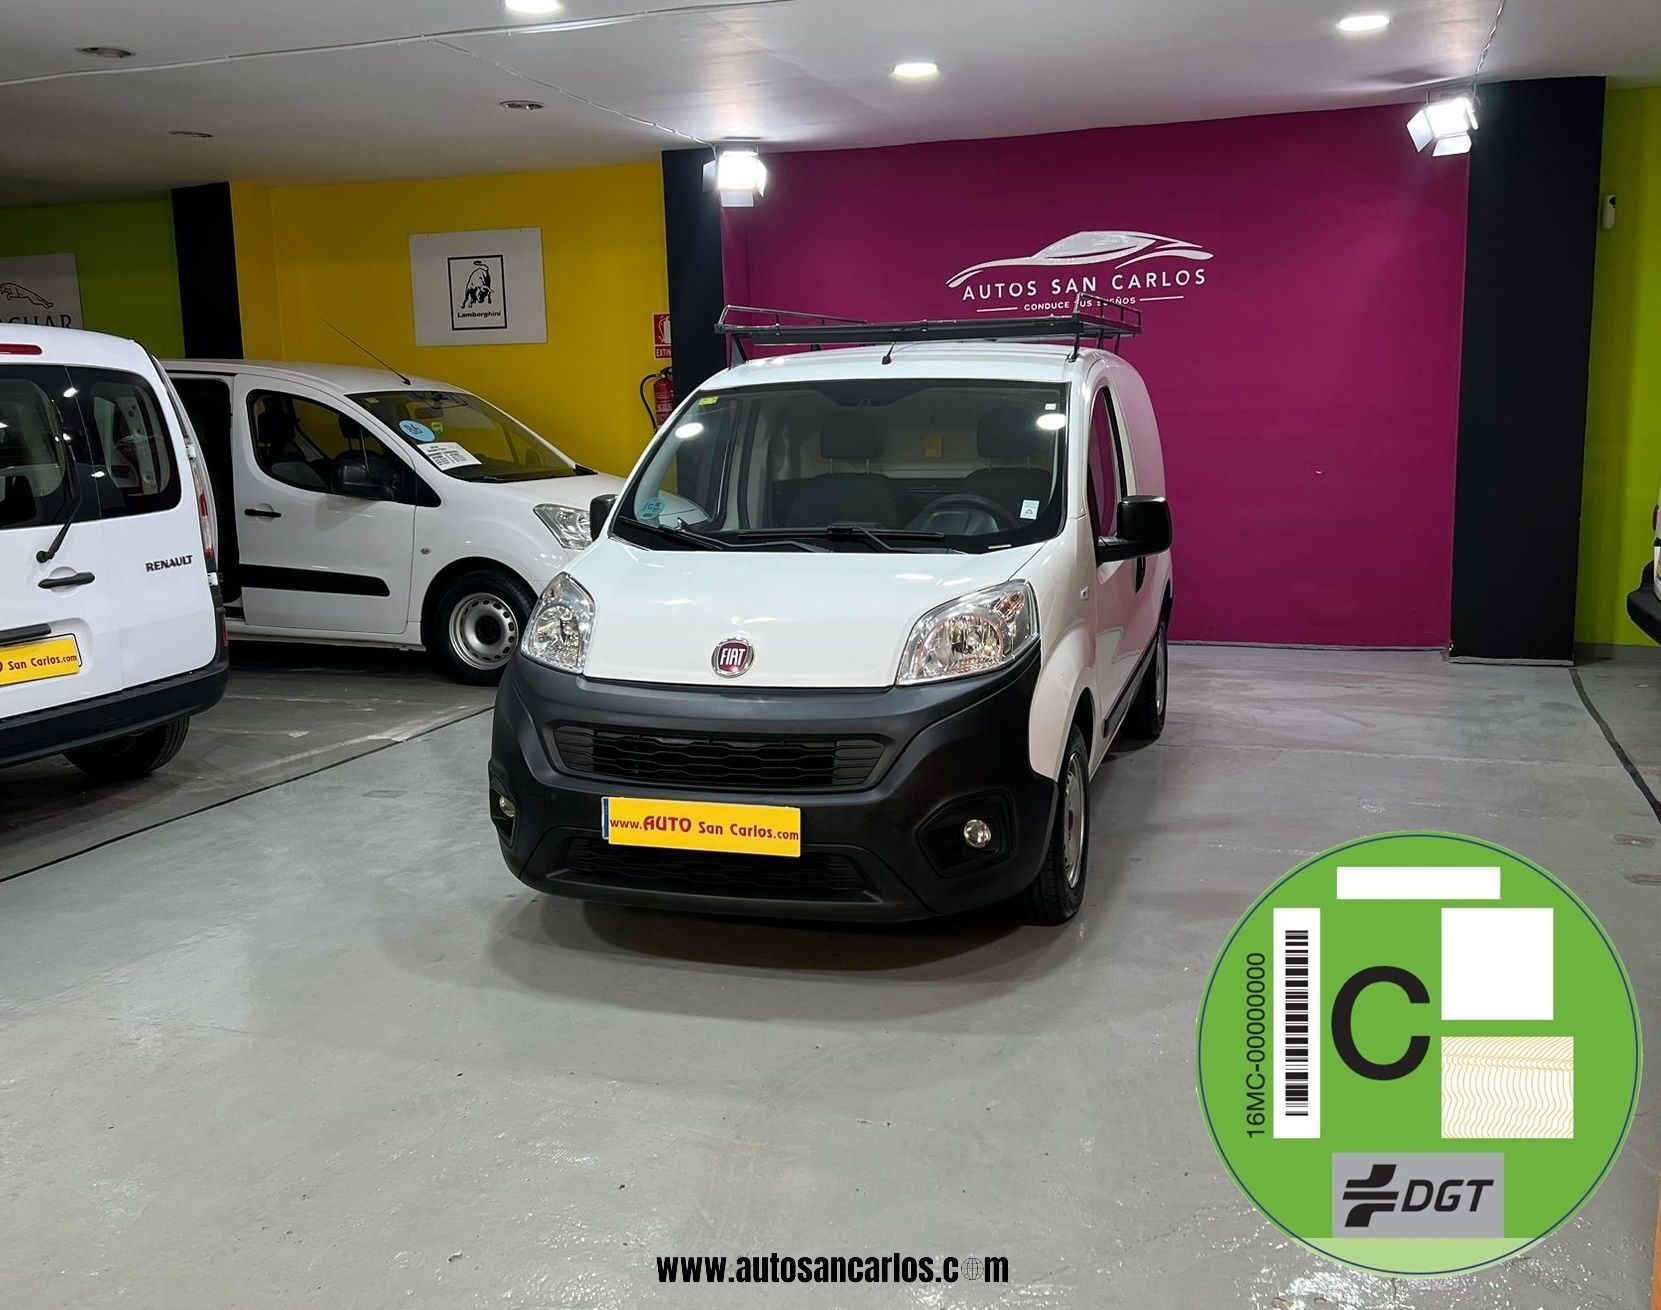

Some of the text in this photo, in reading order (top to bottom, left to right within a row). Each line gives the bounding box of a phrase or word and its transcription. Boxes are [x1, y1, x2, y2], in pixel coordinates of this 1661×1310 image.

[962, 268, 1206, 301] AUTOS SAN CARLOS
[457, 310, 502, 318] Lamborghini
[1023, 301, 1070, 312] CONDUCE
[145, 554, 193, 573] RENAULT
[8, 660, 27, 671] San
[30, 654, 77, 667] Carlos.com
[719, 647, 746, 666] FIAT
[698, 821, 723, 836] San
[729, 823, 799, 841] Carlos.com
